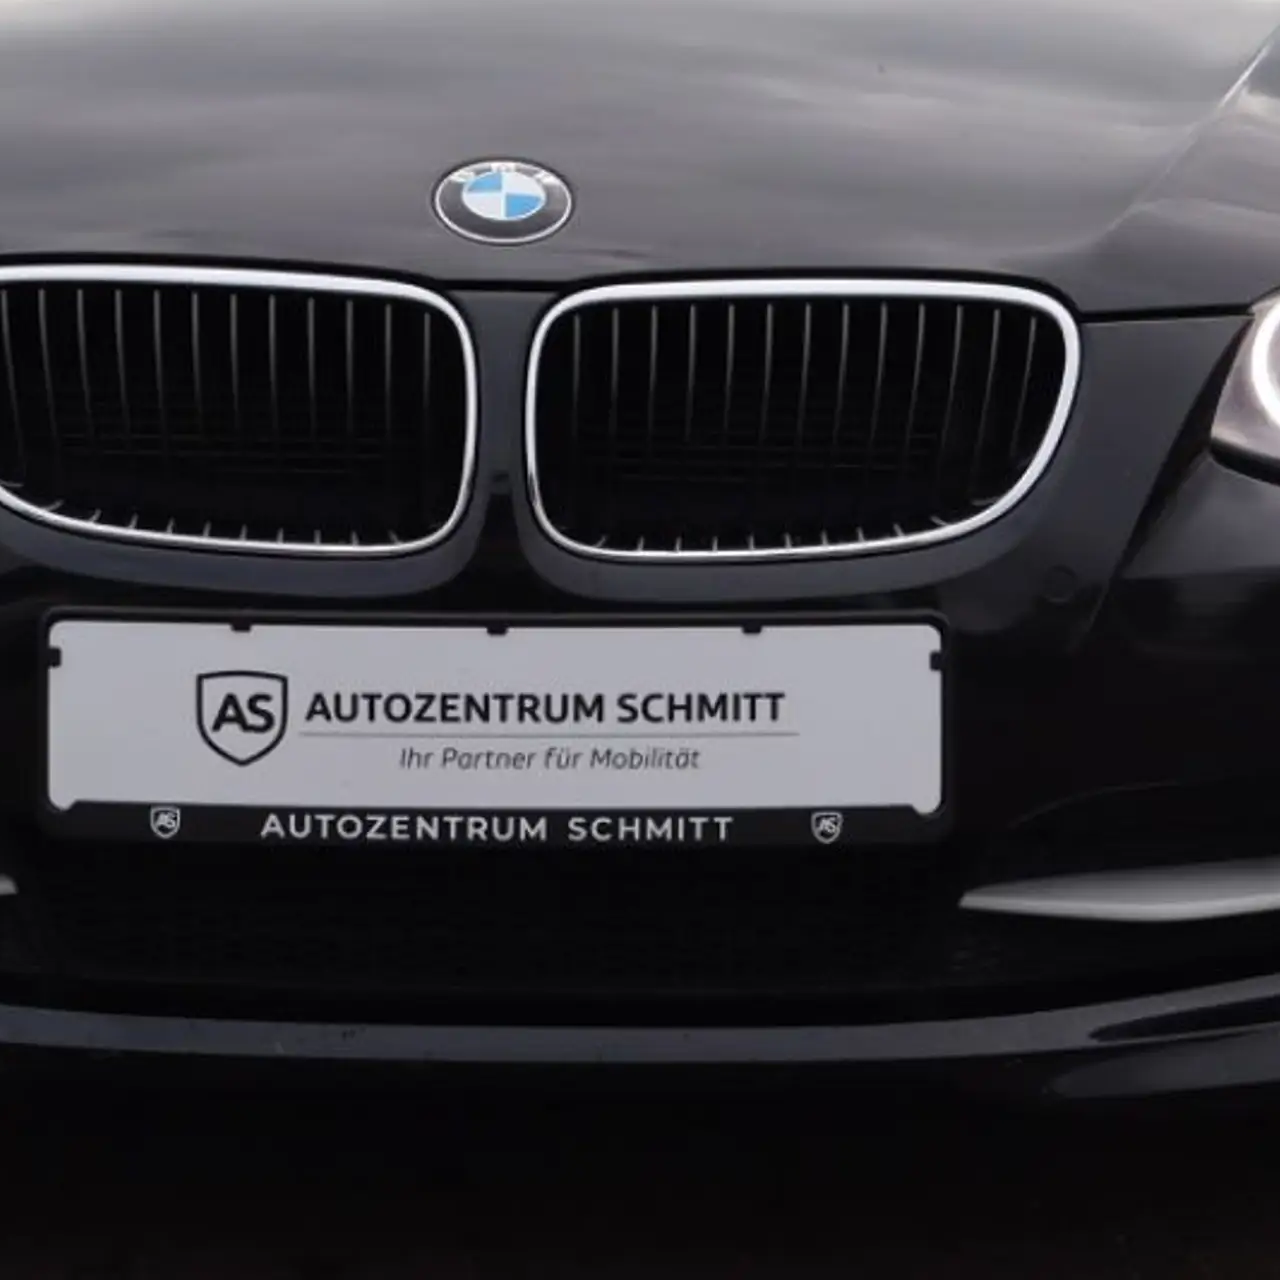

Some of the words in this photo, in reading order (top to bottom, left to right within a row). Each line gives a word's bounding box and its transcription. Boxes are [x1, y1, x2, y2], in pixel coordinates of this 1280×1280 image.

[212, 692, 275, 734] AS
[305, 692, 605, 723] AUTOZENTRUM
[616, 692, 786, 723] SCHMITT
[399, 747, 434, 769] Ihr
[441, 747, 536, 770] Partner
[543, 747, 582, 770] für
[589, 748, 700, 770] Mobilität
[261, 814, 547, 841] AUTOZENTRUM
[568, 816, 734, 841] SCHMITT
